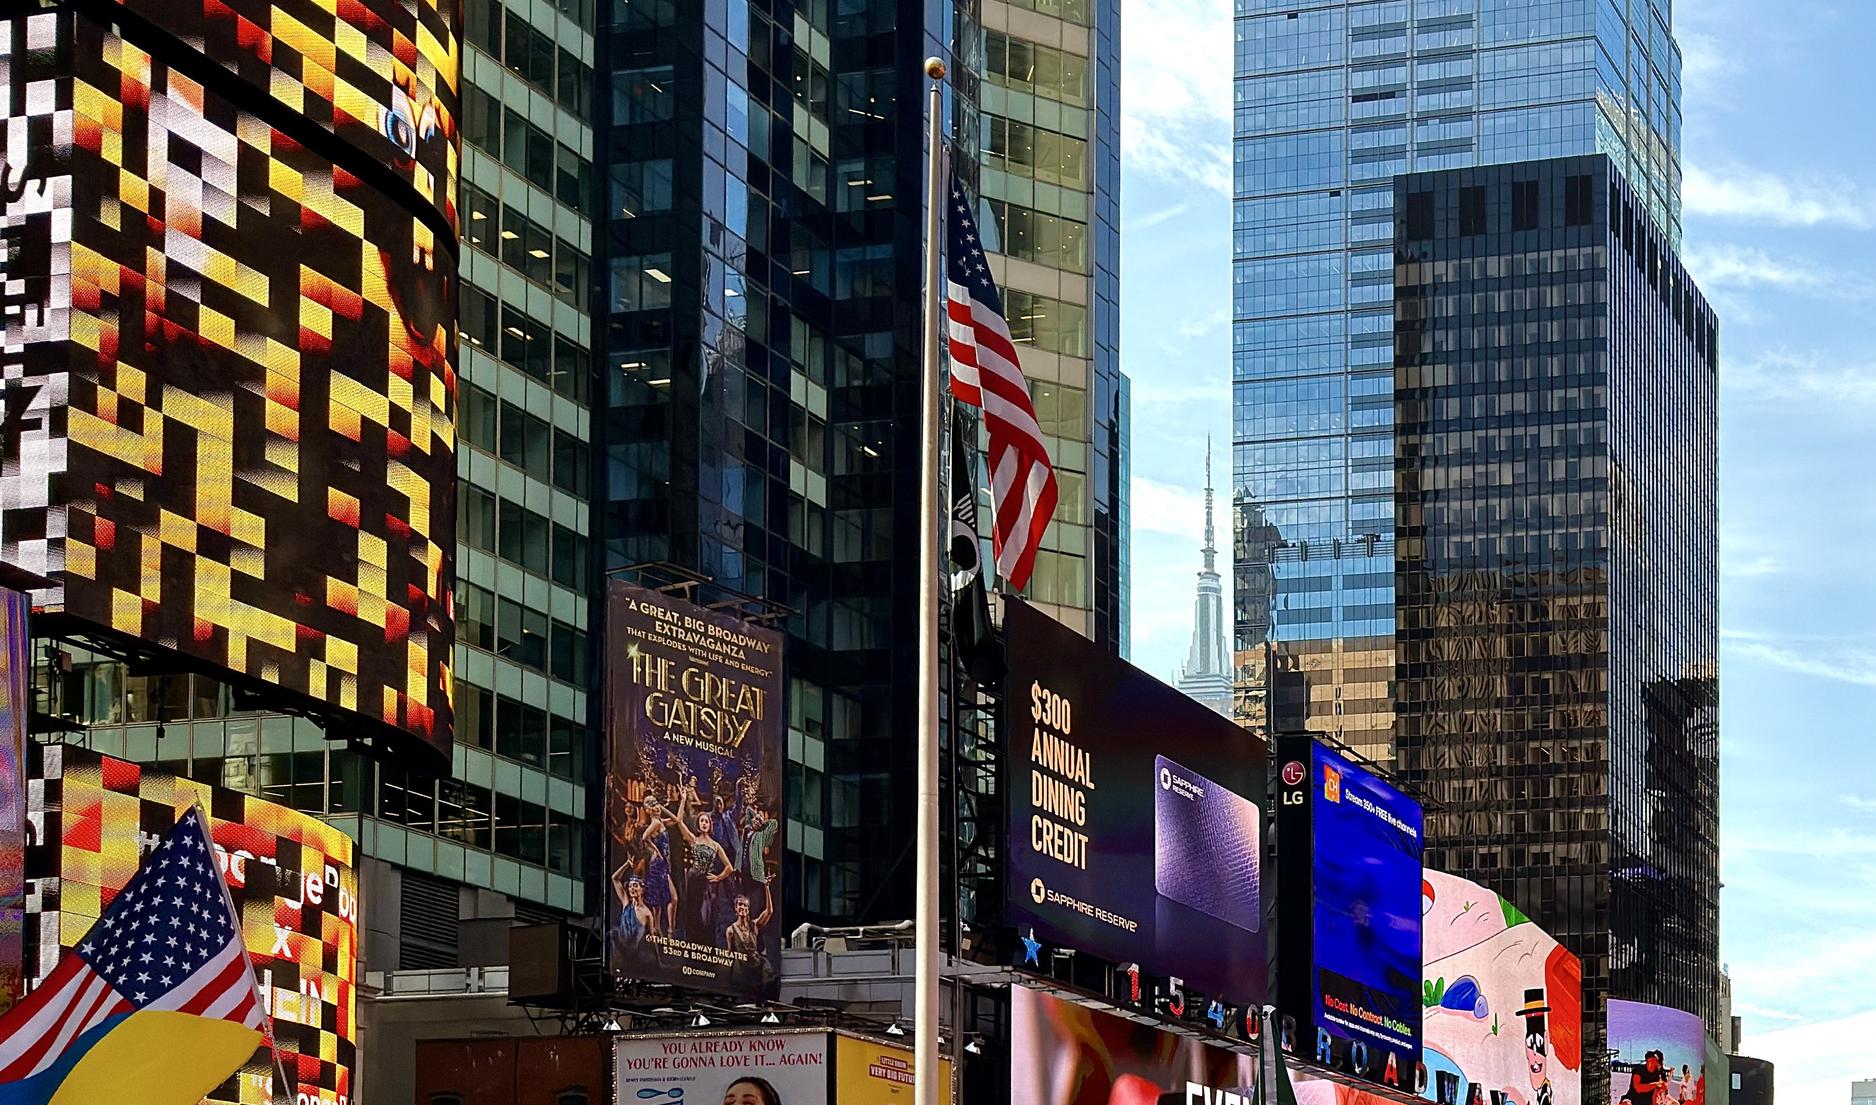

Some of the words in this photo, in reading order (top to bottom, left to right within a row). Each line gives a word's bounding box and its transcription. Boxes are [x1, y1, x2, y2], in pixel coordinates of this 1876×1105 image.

[640, 602, 682, 626] GREAT,
[685, 617, 705, 633] BIG
[708, 624, 770, 654] BROADWAY
[655, 621, 746, 660] EXTRAVAGANZA
[627, 627, 646, 638] THAT
[648, 633, 687, 651] EXPLODES
[688, 645, 707, 658] WITH
[708, 652, 723, 664] LIFE
[724, 658, 739, 669] AND
[631, 650, 676, 694] THE
[682, 667, 768, 721] GREAT
[645, 692, 752, 748] GATSBY
[1031, 680, 1071, 735] $300
[663, 731, 671, 741] A
[672, 733, 693, 746] NEW
[695, 738, 735, 758] MUSICAL
[1031, 728, 1095, 789] ANNUAL
[1032, 769, 1086, 827] DINING
[1172, 774, 1205, 797] SAPPHIRE
[1172, 786, 1195, 801] RESERVE
[1283, 791, 1304, 805] LG
[1031, 814, 1089, 870] CREDIT
[1396, 819, 1417, 838] channels
[1047, 889, 1094, 917] SAPPHIRE
[669, 938, 713, 955] BROADWAY
[714, 947, 748, 961] THEATRE
[691, 954, 734, 967] BROADWAY
[662, 1042, 688, 1055] YOU
[690, 1040, 745, 1054] ALREADY
[750, 1039, 786, 1051] KNOW
[627, 1057, 668, 1070] YOU'RE
[672, 1055, 715, 1068] GONNA
[720, 1055, 750, 1068] LOVE
[754, 1054, 776, 1066] IT...
[780, 1052, 823, 1066] AGAIN!
[870, 1066, 886, 1077] VERY
